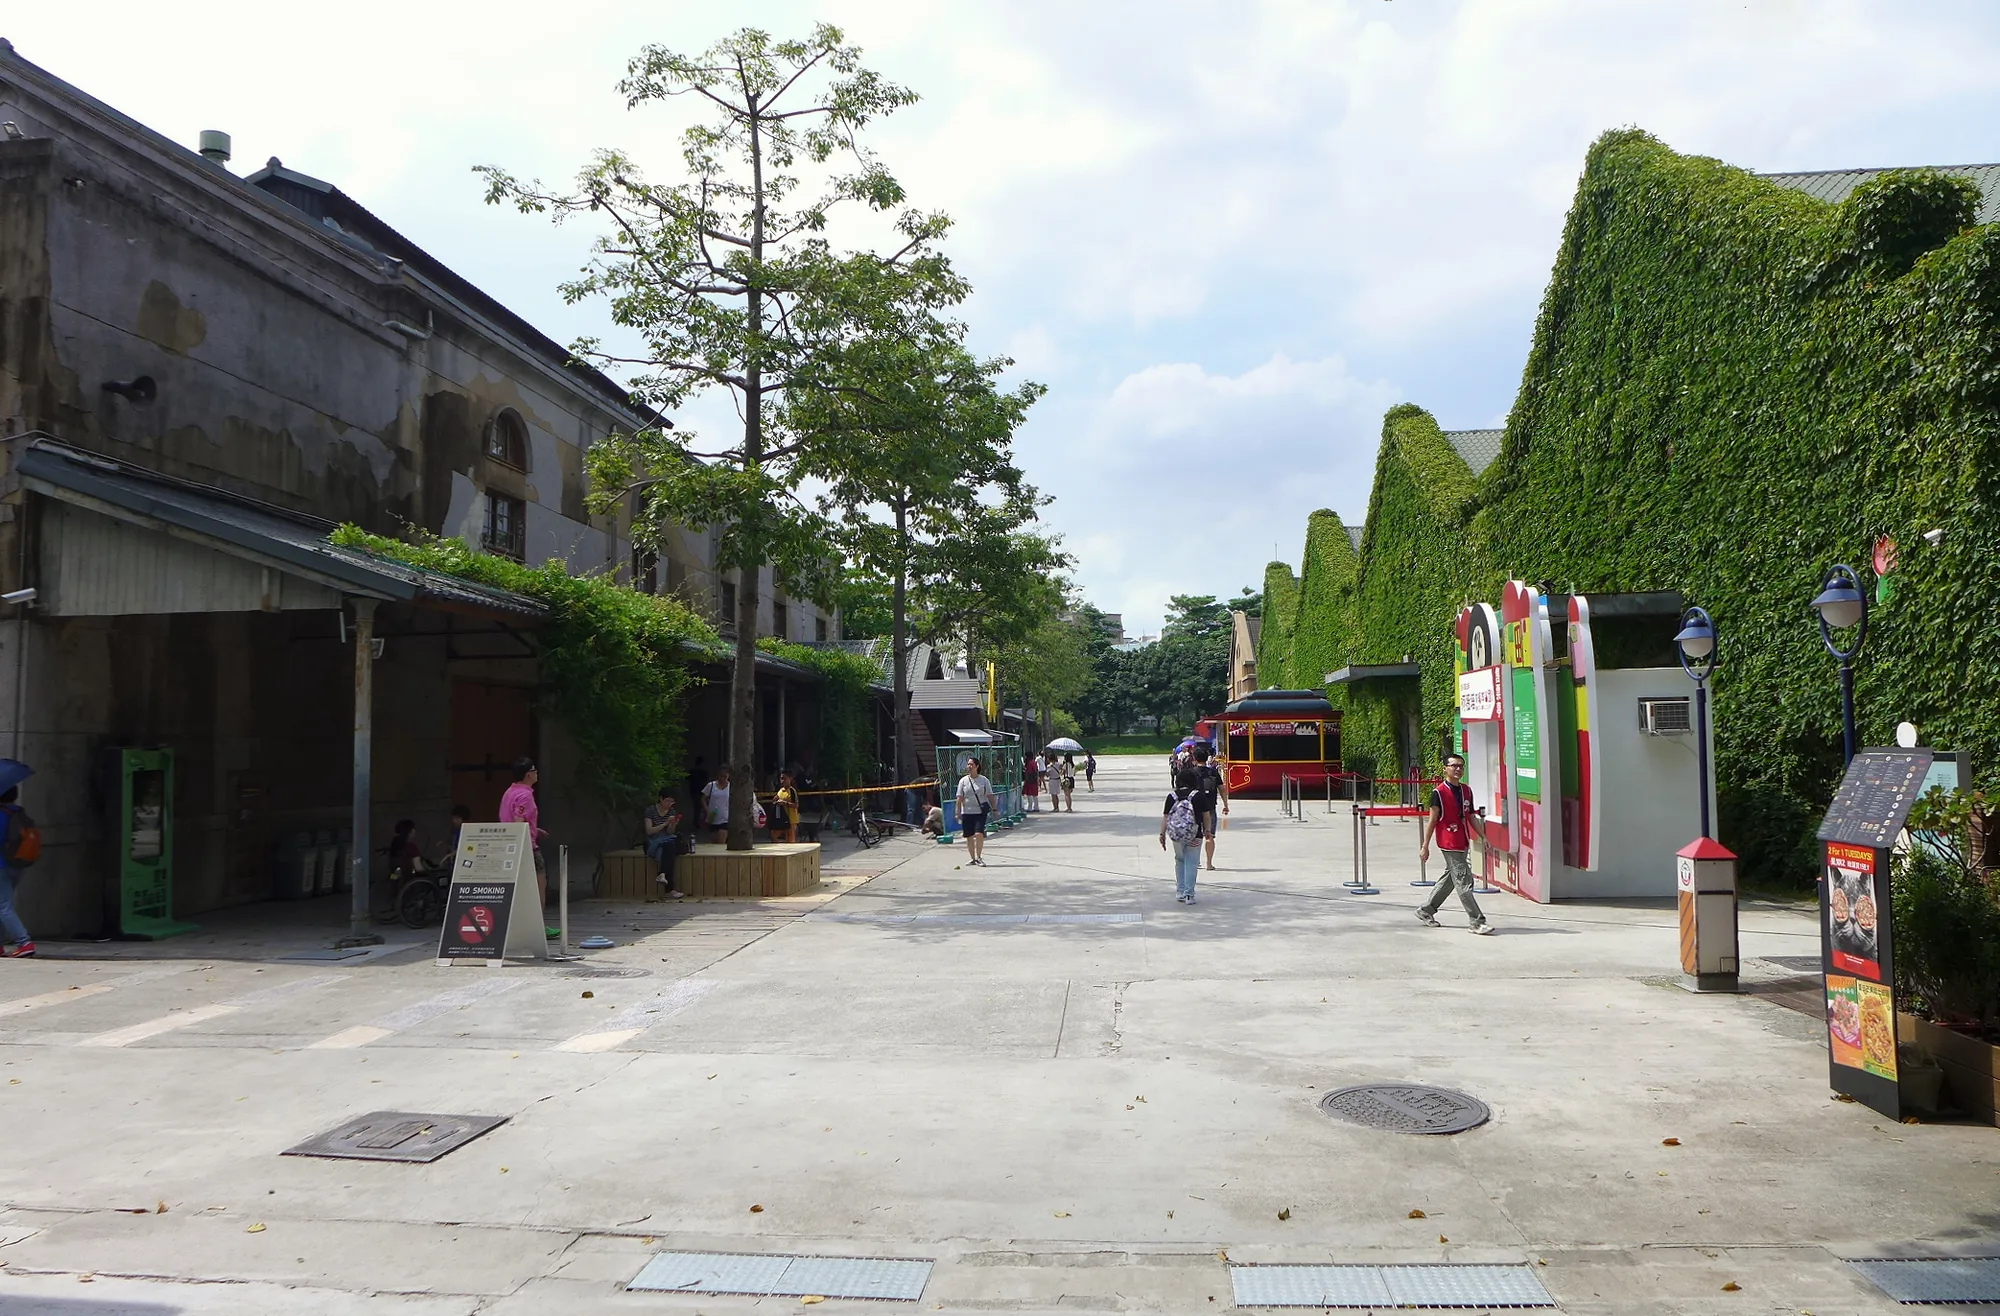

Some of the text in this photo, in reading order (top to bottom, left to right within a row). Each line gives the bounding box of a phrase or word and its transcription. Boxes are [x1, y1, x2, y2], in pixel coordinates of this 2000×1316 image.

[1832, 847, 1840, 856] For
[459, 886, 505, 894] NO SMOKING
